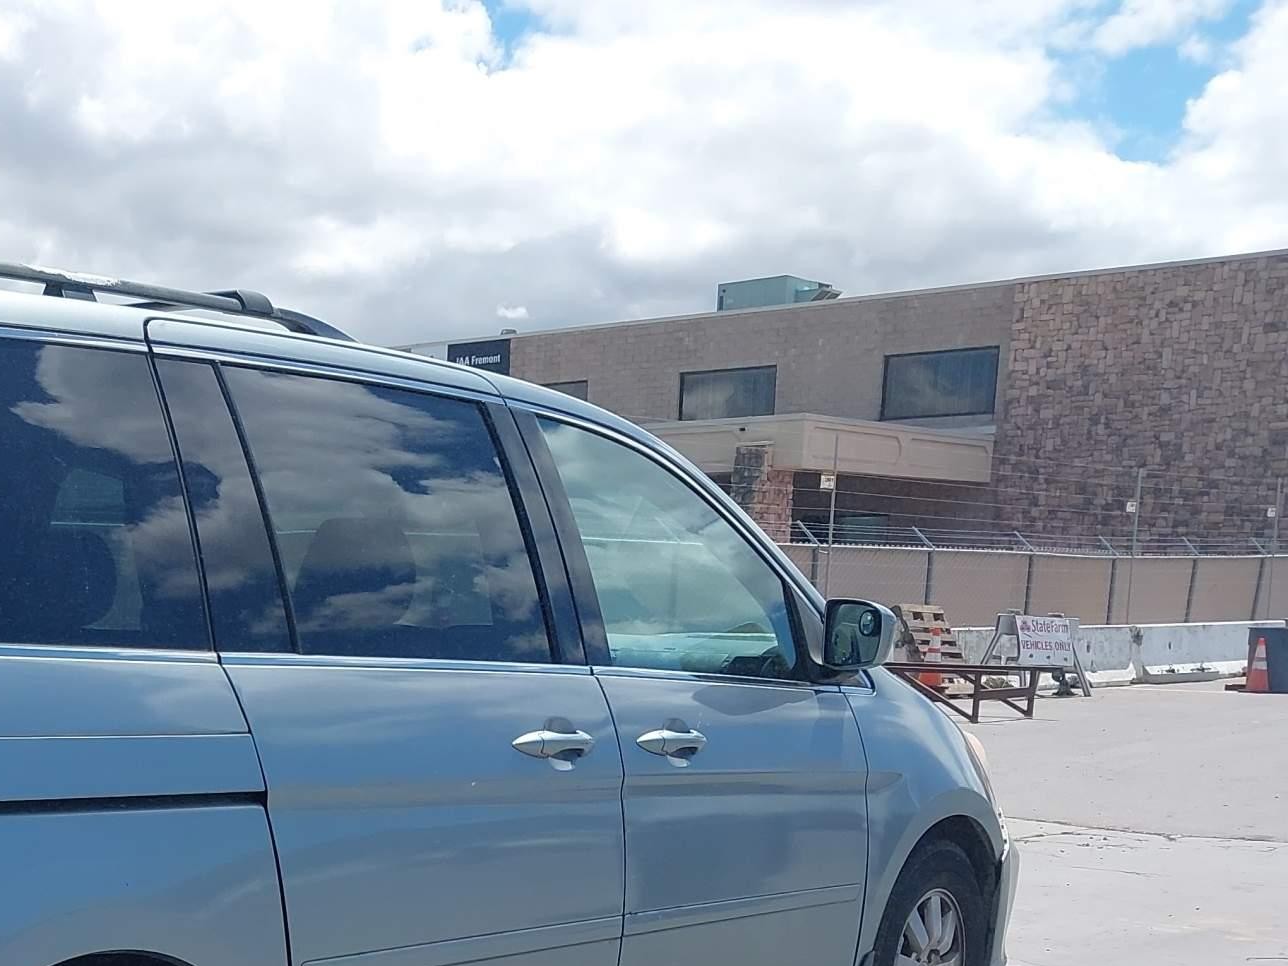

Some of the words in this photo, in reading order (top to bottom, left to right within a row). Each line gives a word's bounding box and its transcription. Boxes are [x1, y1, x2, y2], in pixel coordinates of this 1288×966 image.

[471, 354, 501, 366] Fremont
[1021, 639, 1053, 651] VEHICLES
[1054, 640, 1071, 652] ONLY
